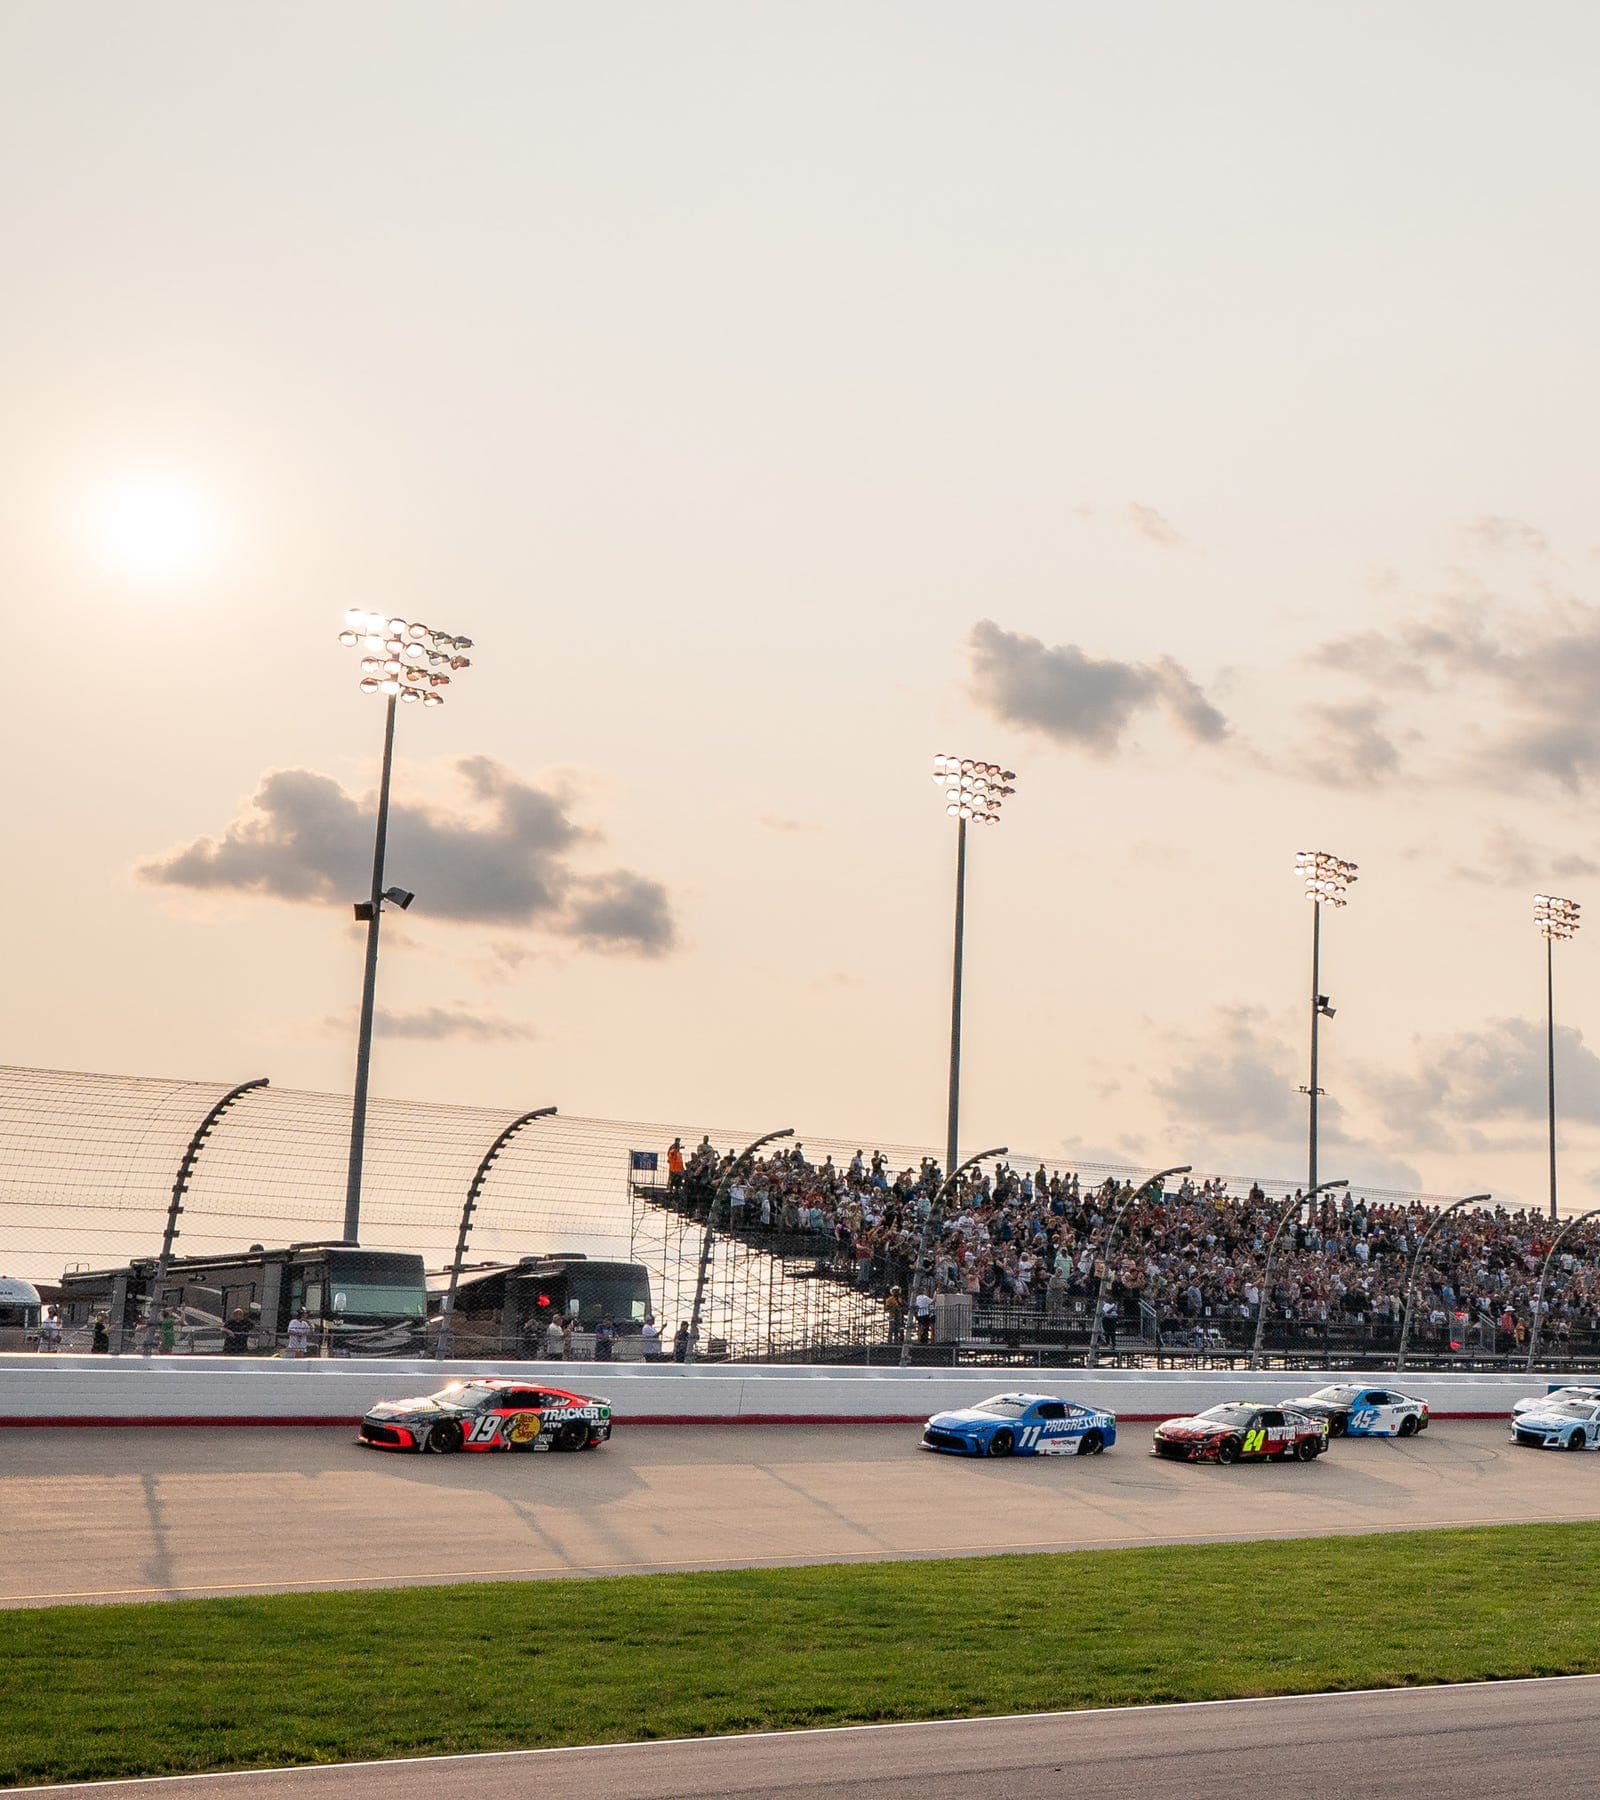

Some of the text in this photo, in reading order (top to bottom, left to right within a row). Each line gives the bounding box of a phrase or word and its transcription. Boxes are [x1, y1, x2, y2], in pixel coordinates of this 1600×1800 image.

[542, 1407, 599, 1420] TRACKER
[1351, 1410, 1374, 1429] 45
[467, 1415, 502, 1441] 19
[1042, 1417, 1108, 1433] PROGRESSIVE
[1018, 1426, 1042, 1447] 11
[1242, 1429, 1266, 1452] 24
